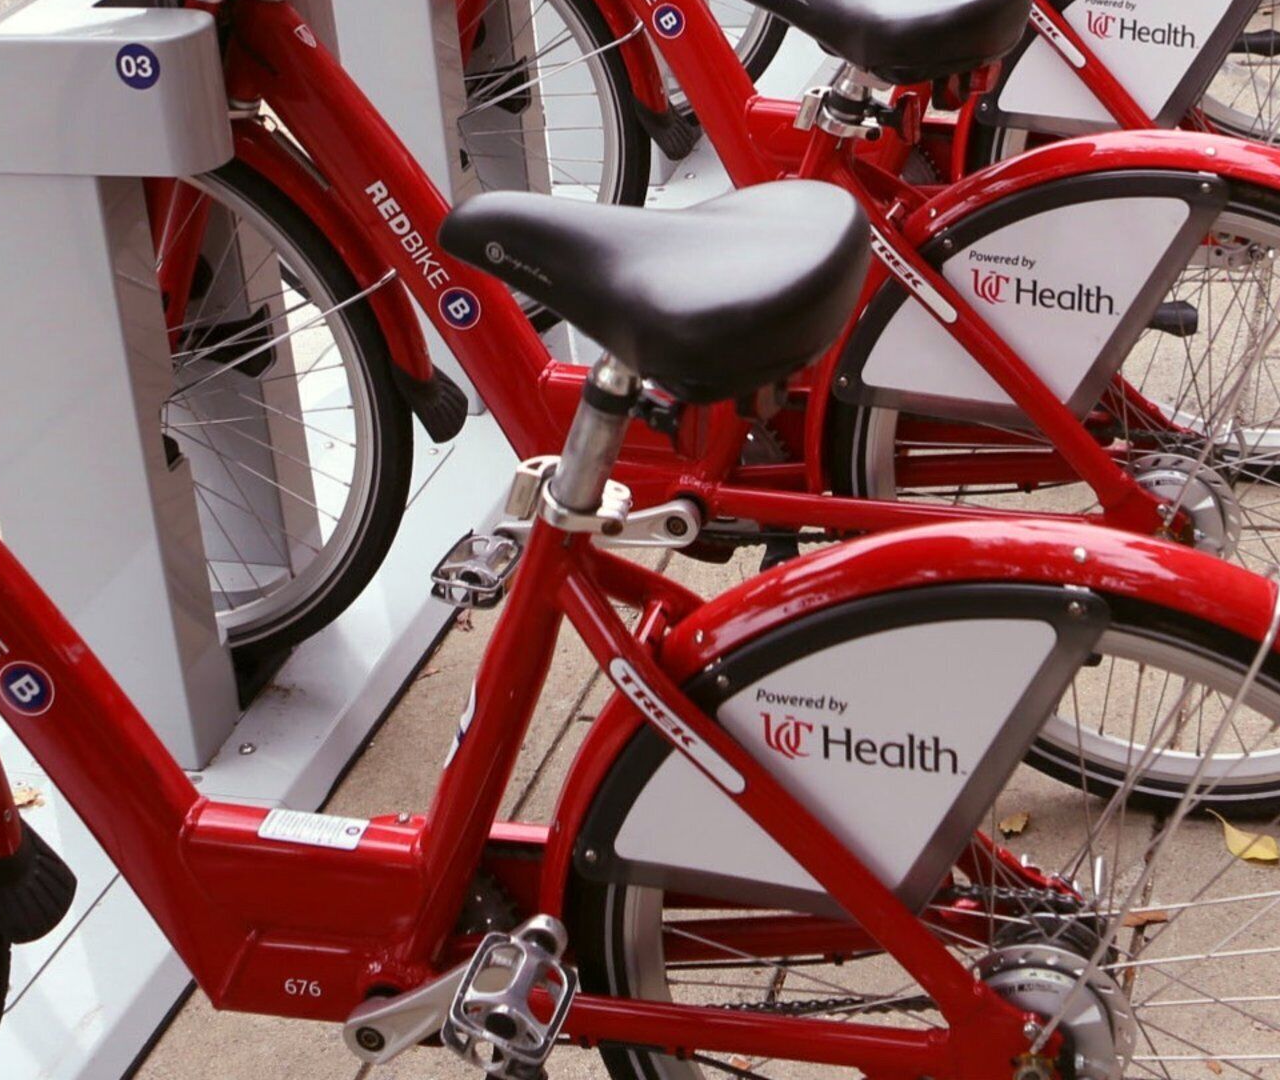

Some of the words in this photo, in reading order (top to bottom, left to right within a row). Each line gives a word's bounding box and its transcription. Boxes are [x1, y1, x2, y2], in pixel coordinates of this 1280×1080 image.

[1123, 0, 1137, 11] by
[660, 12, 678, 30] B
[1119, 17, 1195, 49] Health
[120, 55, 153, 78] 03
[364, 180, 450, 290] REDBIKE
[447, 297, 471, 320] B
[969, 250, 1019, 267] Powered
[1021, 256, 1036, 269] by
[1015, 278, 1115, 316] Health
[9, 674, 41, 703] B
[756, 688, 825, 710] Powered
[828, 695, 849, 715] by
[620, 665, 699, 748] TREK
[821, 725, 959, 776] Health
[284, 978, 321, 997] 676
